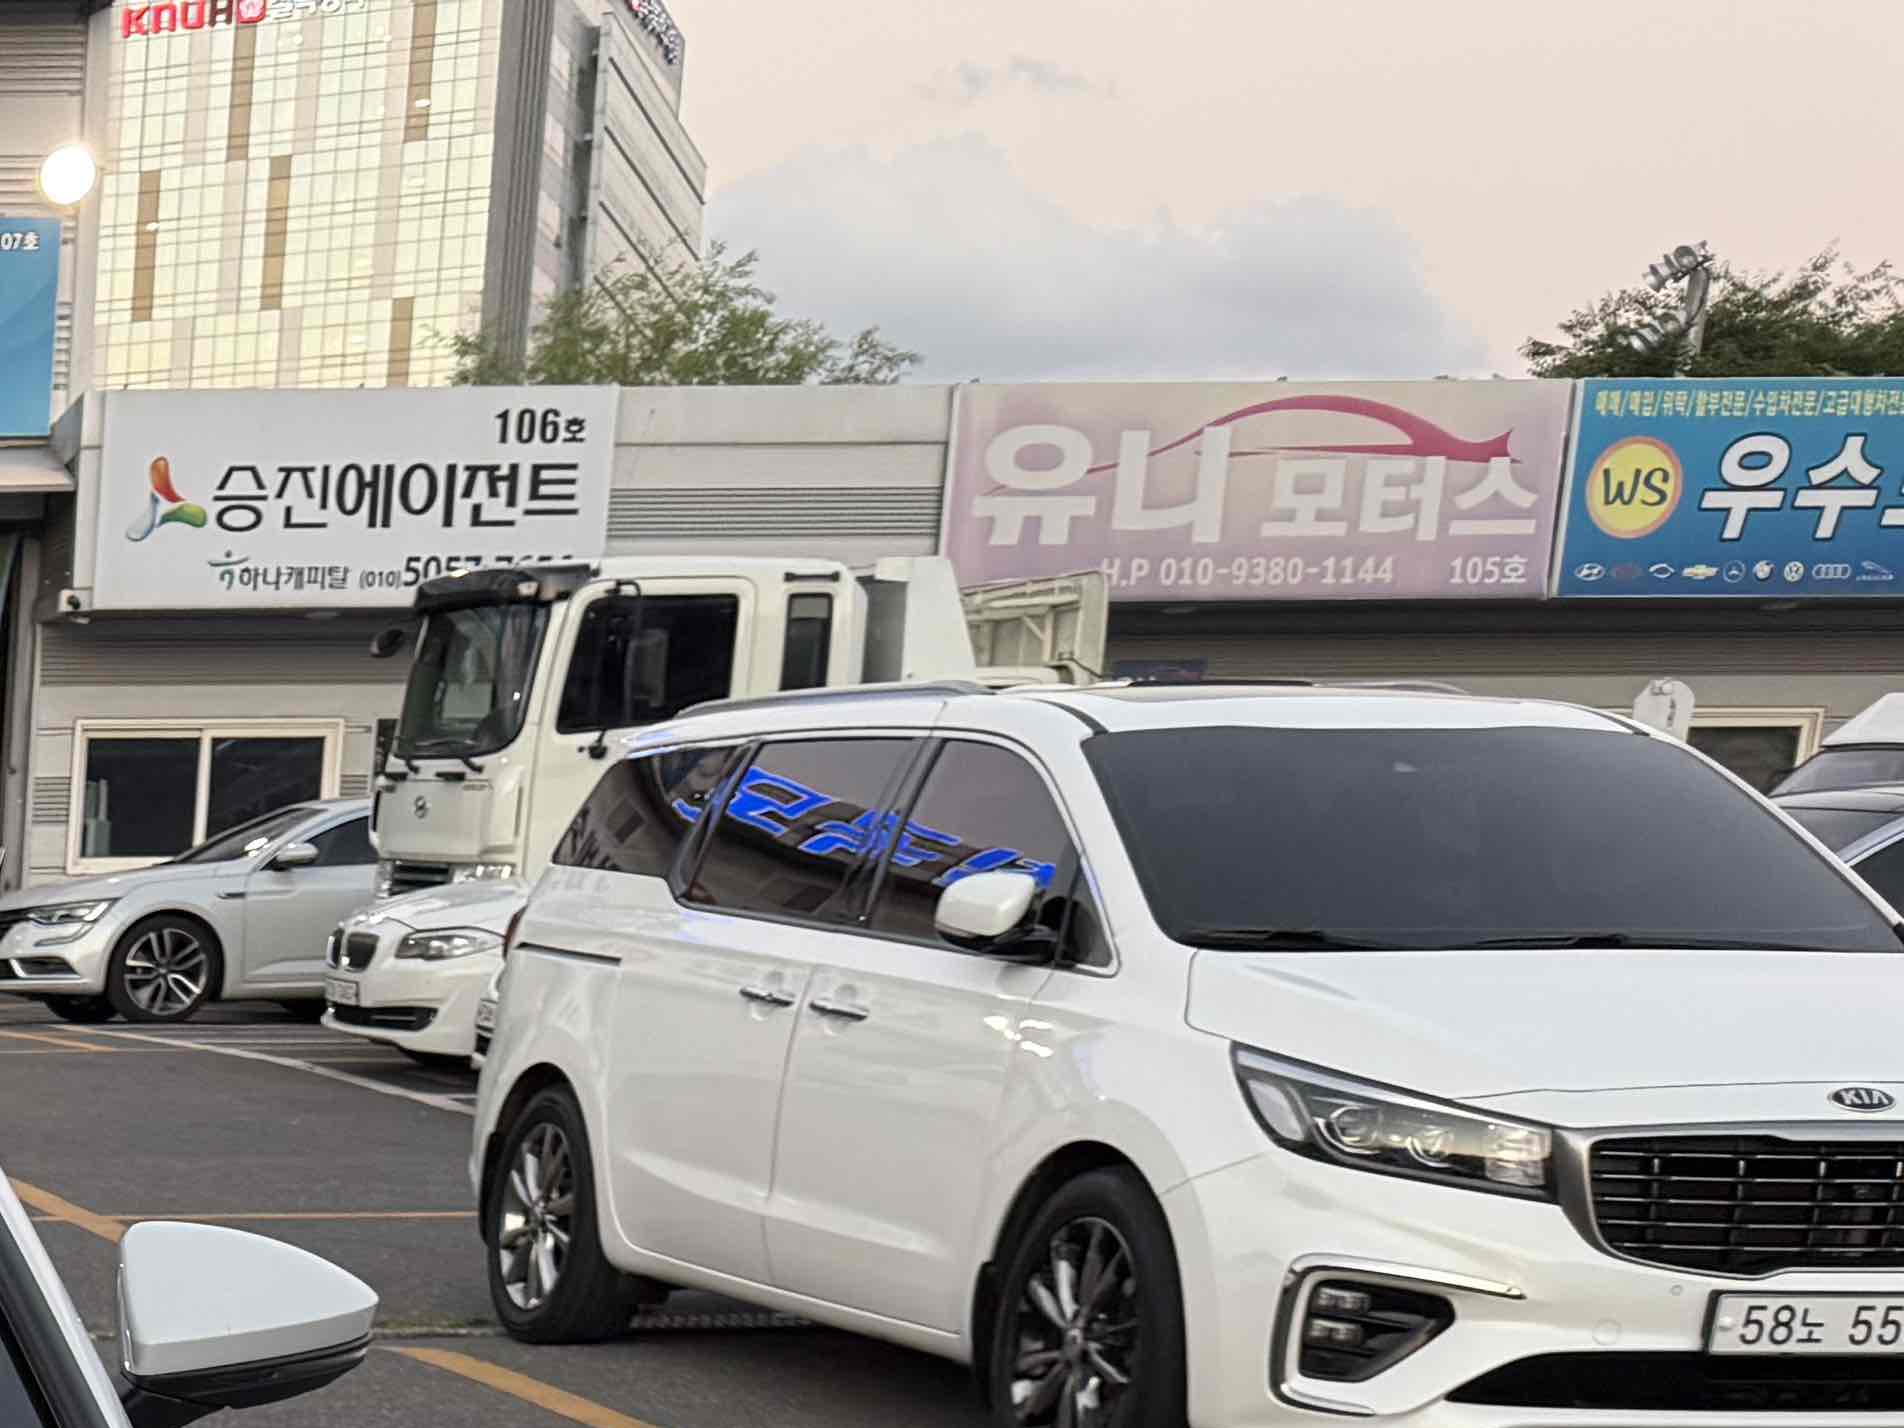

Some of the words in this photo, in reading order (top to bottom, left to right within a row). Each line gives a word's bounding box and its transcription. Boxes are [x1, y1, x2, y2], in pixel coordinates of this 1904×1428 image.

[494, 408, 587, 445] 106호
[211, 461, 580, 533] 승진에이전트
[972, 423, 1233, 545] 유니
[1261, 455, 1538, 542] 모터스
[1601, 467, 1670, 508] WS
[1698, 431, 1904, 542] 우수
[239, 565, 351, 591] 하나캐피탈
[1159, 555, 1394, 586] 010-9380-1144
[1449, 554, 1527, 585] 105호
[1839, 1088, 1889, 1105] KIA
[1739, 1303, 1825, 1346] 58노
